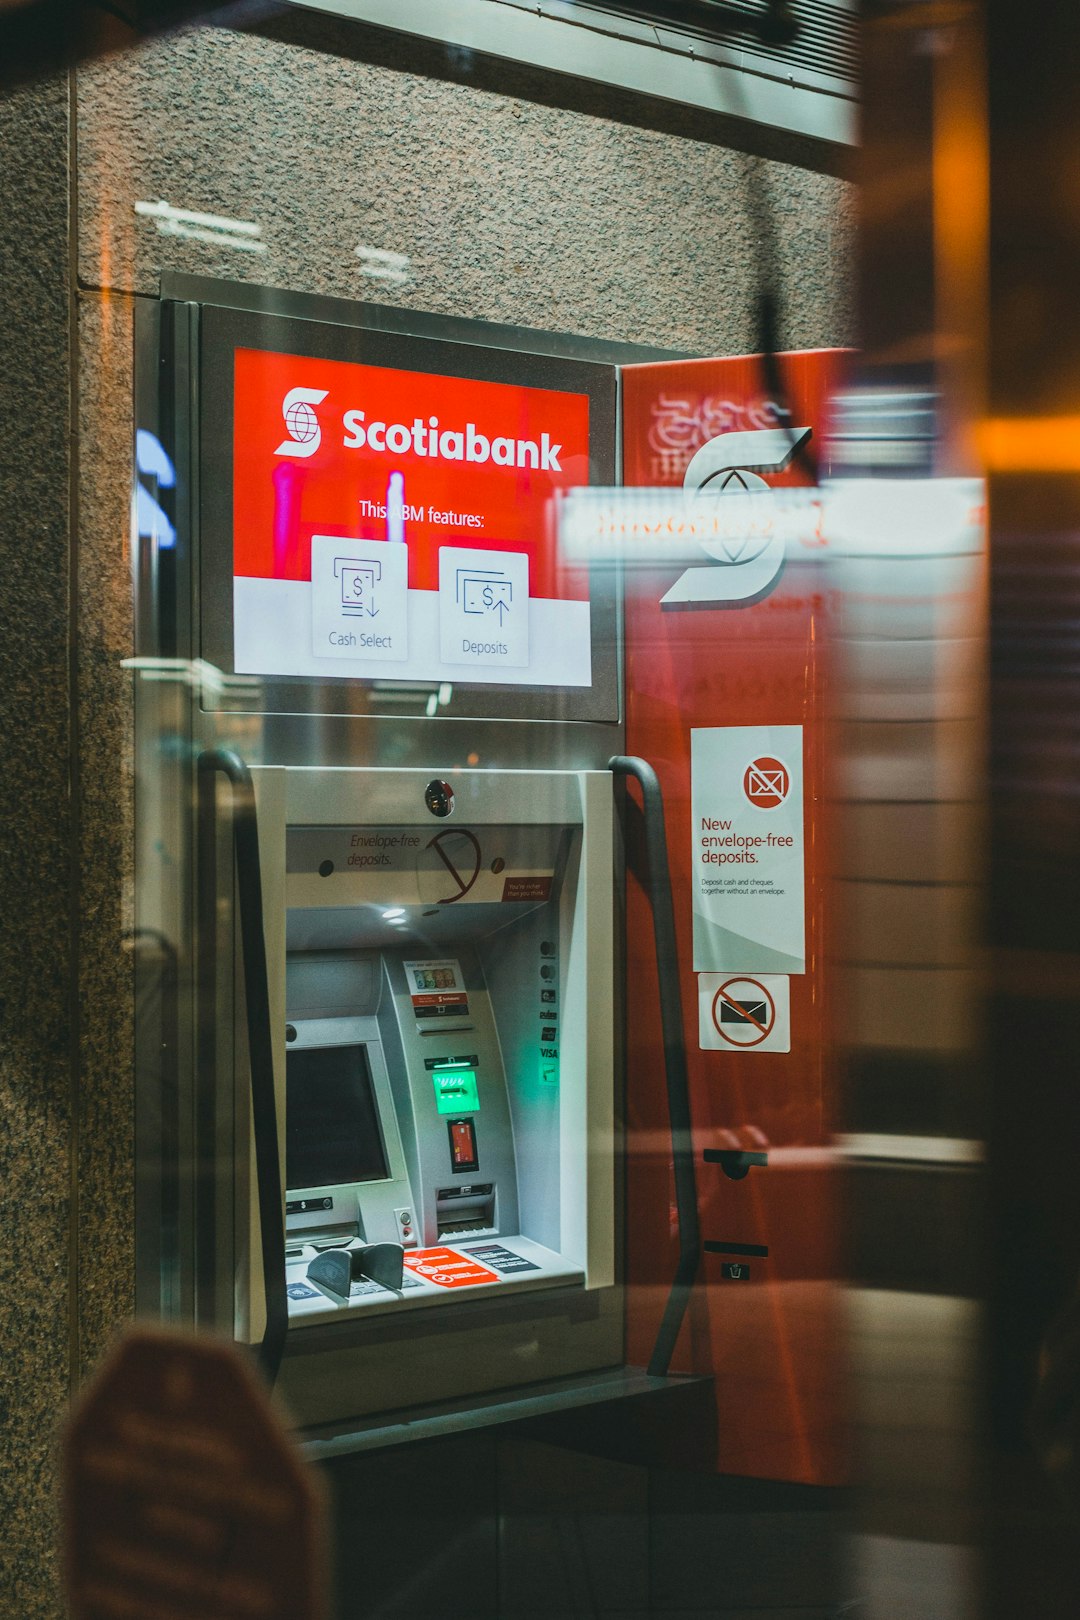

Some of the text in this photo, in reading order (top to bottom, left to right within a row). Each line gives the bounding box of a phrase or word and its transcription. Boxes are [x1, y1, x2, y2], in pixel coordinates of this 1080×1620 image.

[342, 409, 562, 472] Scotiabank
[359, 500, 387, 518] This
[428, 506, 485, 528] features:
[328, 632, 392, 649] Cash Select
[462, 639, 508, 656] Deposits
[701, 817, 732, 830] New
[350, 833, 420, 849] Envelope-free
[701, 833, 794, 850] envelope-free
[347, 853, 391, 867] deposits.
[701, 849, 759, 867] deposits.
[701, 878, 774, 887] Deposit cash and cheques
[701, 888, 725, 896] together
[540, 1048, 558, 1058] VISA
